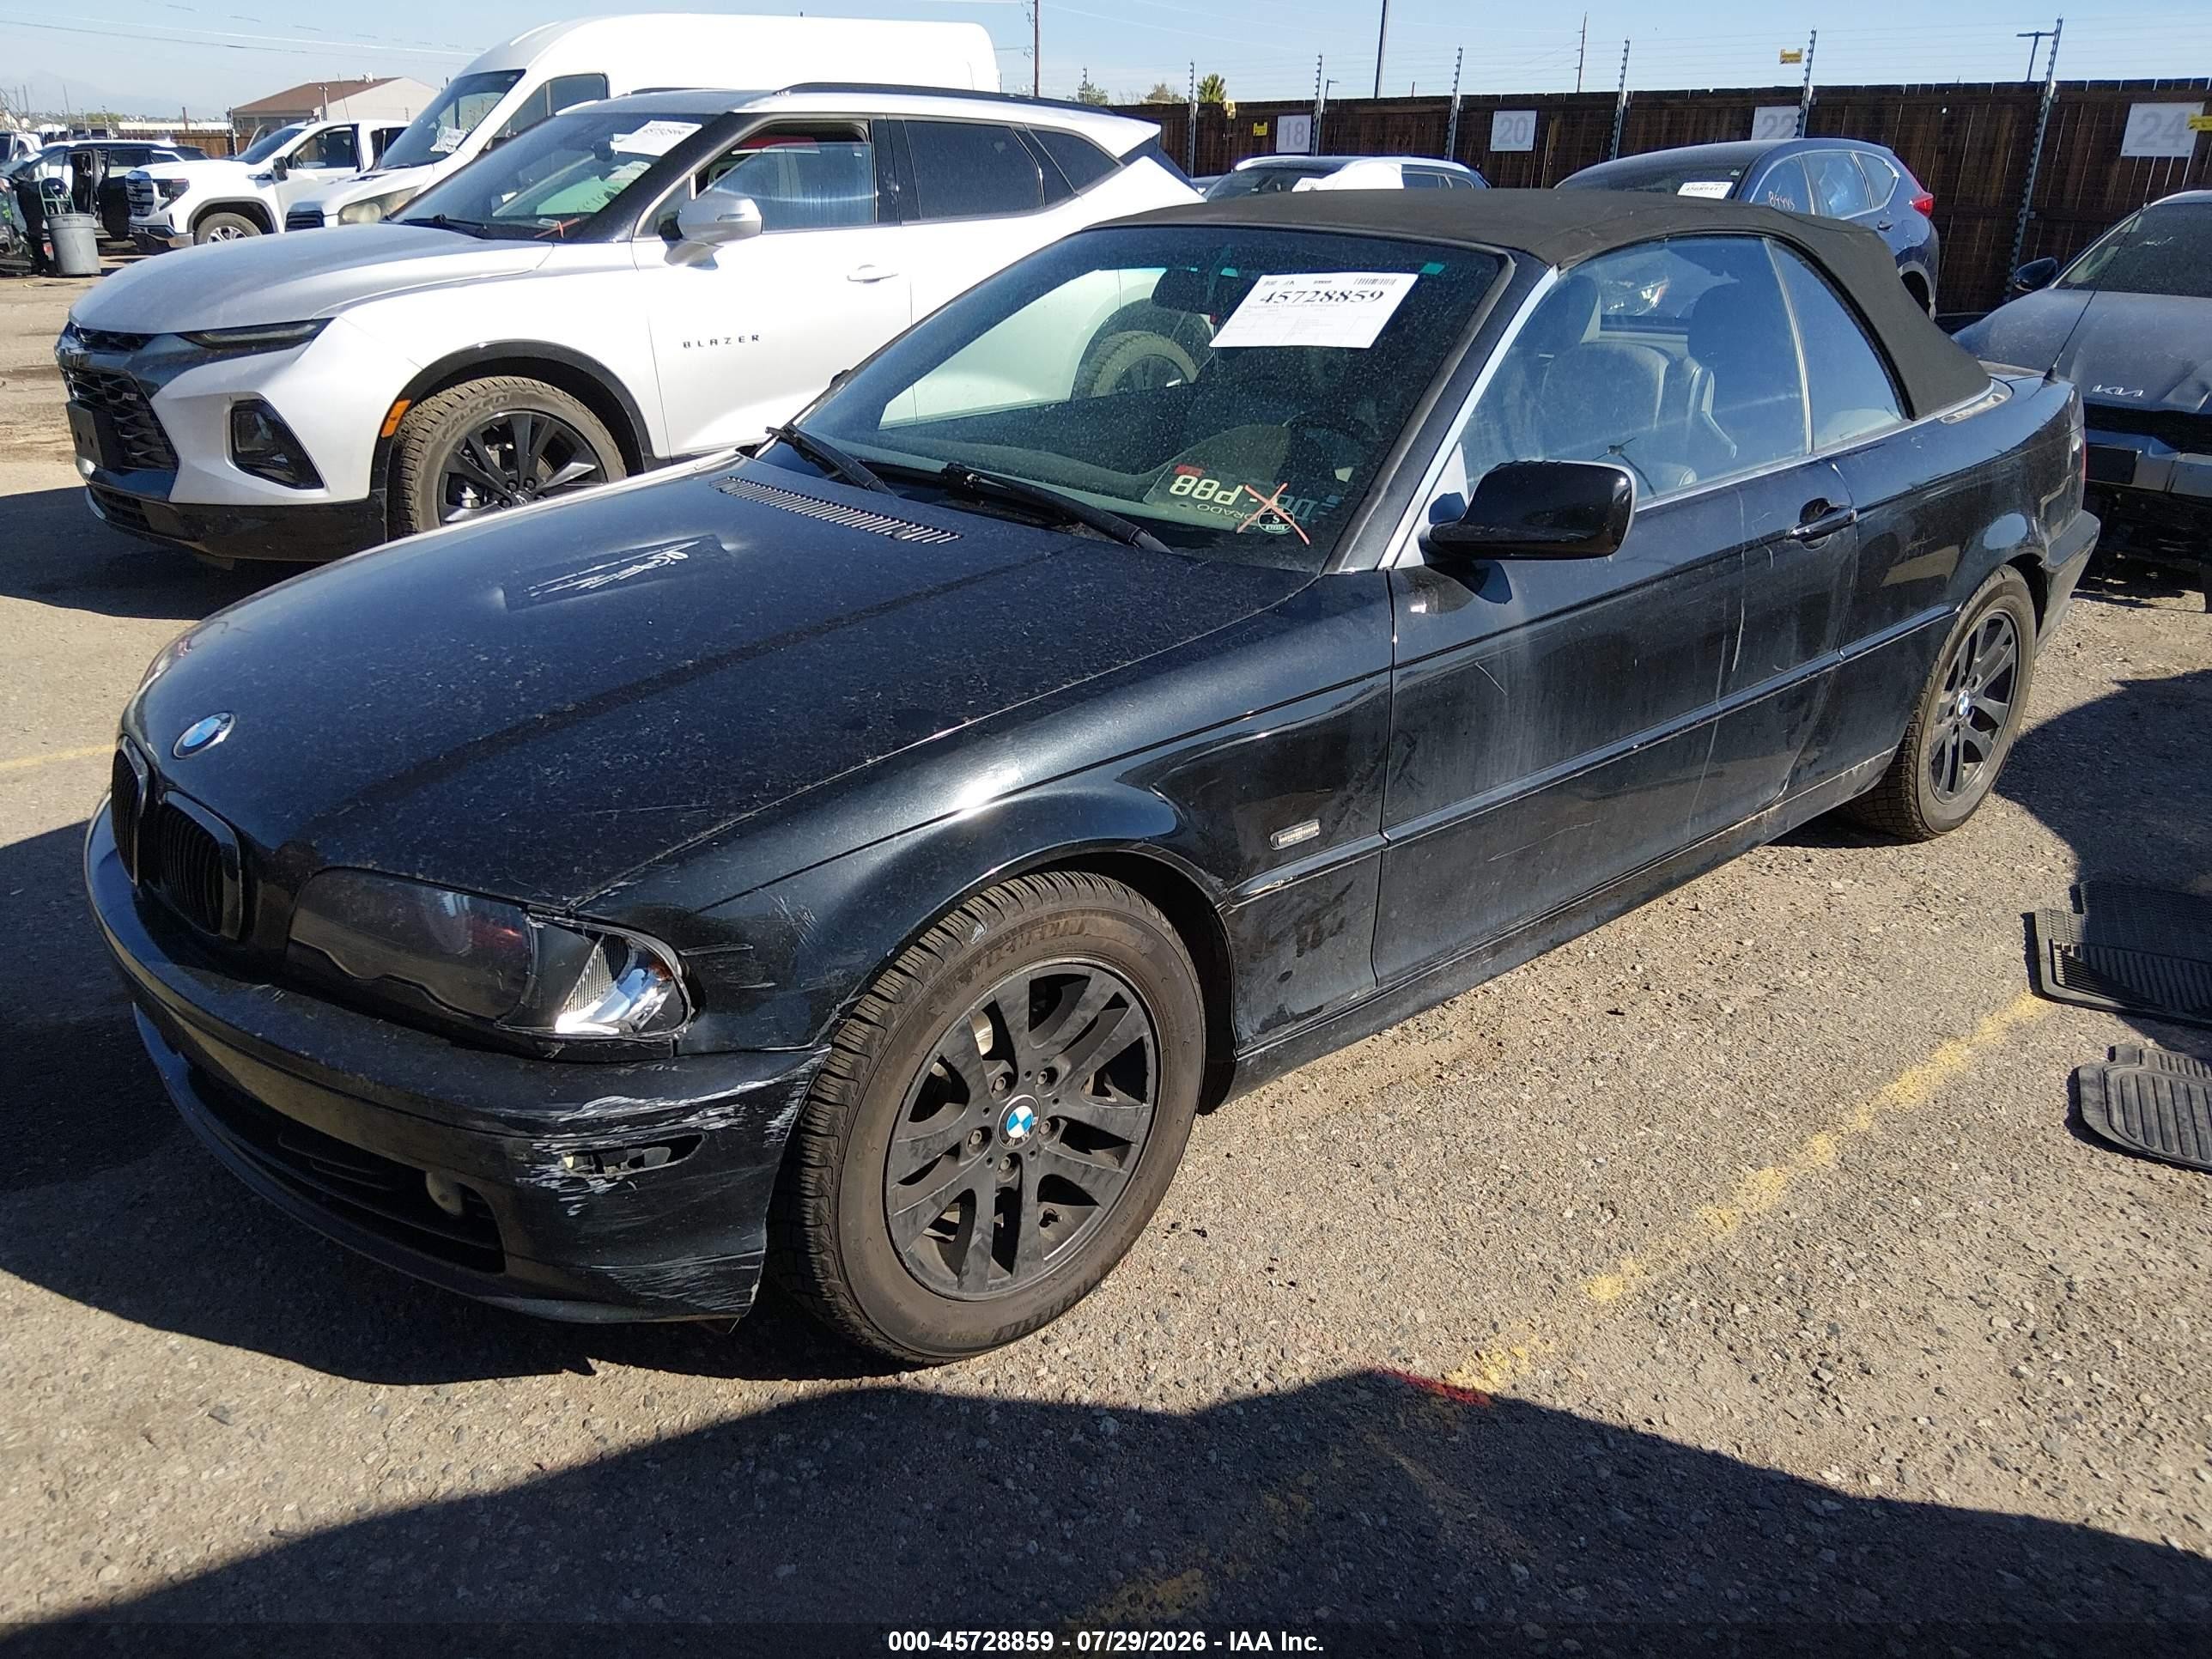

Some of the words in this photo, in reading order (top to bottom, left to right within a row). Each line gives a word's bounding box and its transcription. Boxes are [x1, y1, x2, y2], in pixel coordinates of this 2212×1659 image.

[1283, 121, 1305, 147] 18
[1498, 116, 1528, 144] 20
[1760, 114, 1796, 139] 22
[2133, 111, 2185, 148] 24
[1260, 290, 1384, 304] 45728859
[683, 334, 759, 349] BLAZER
